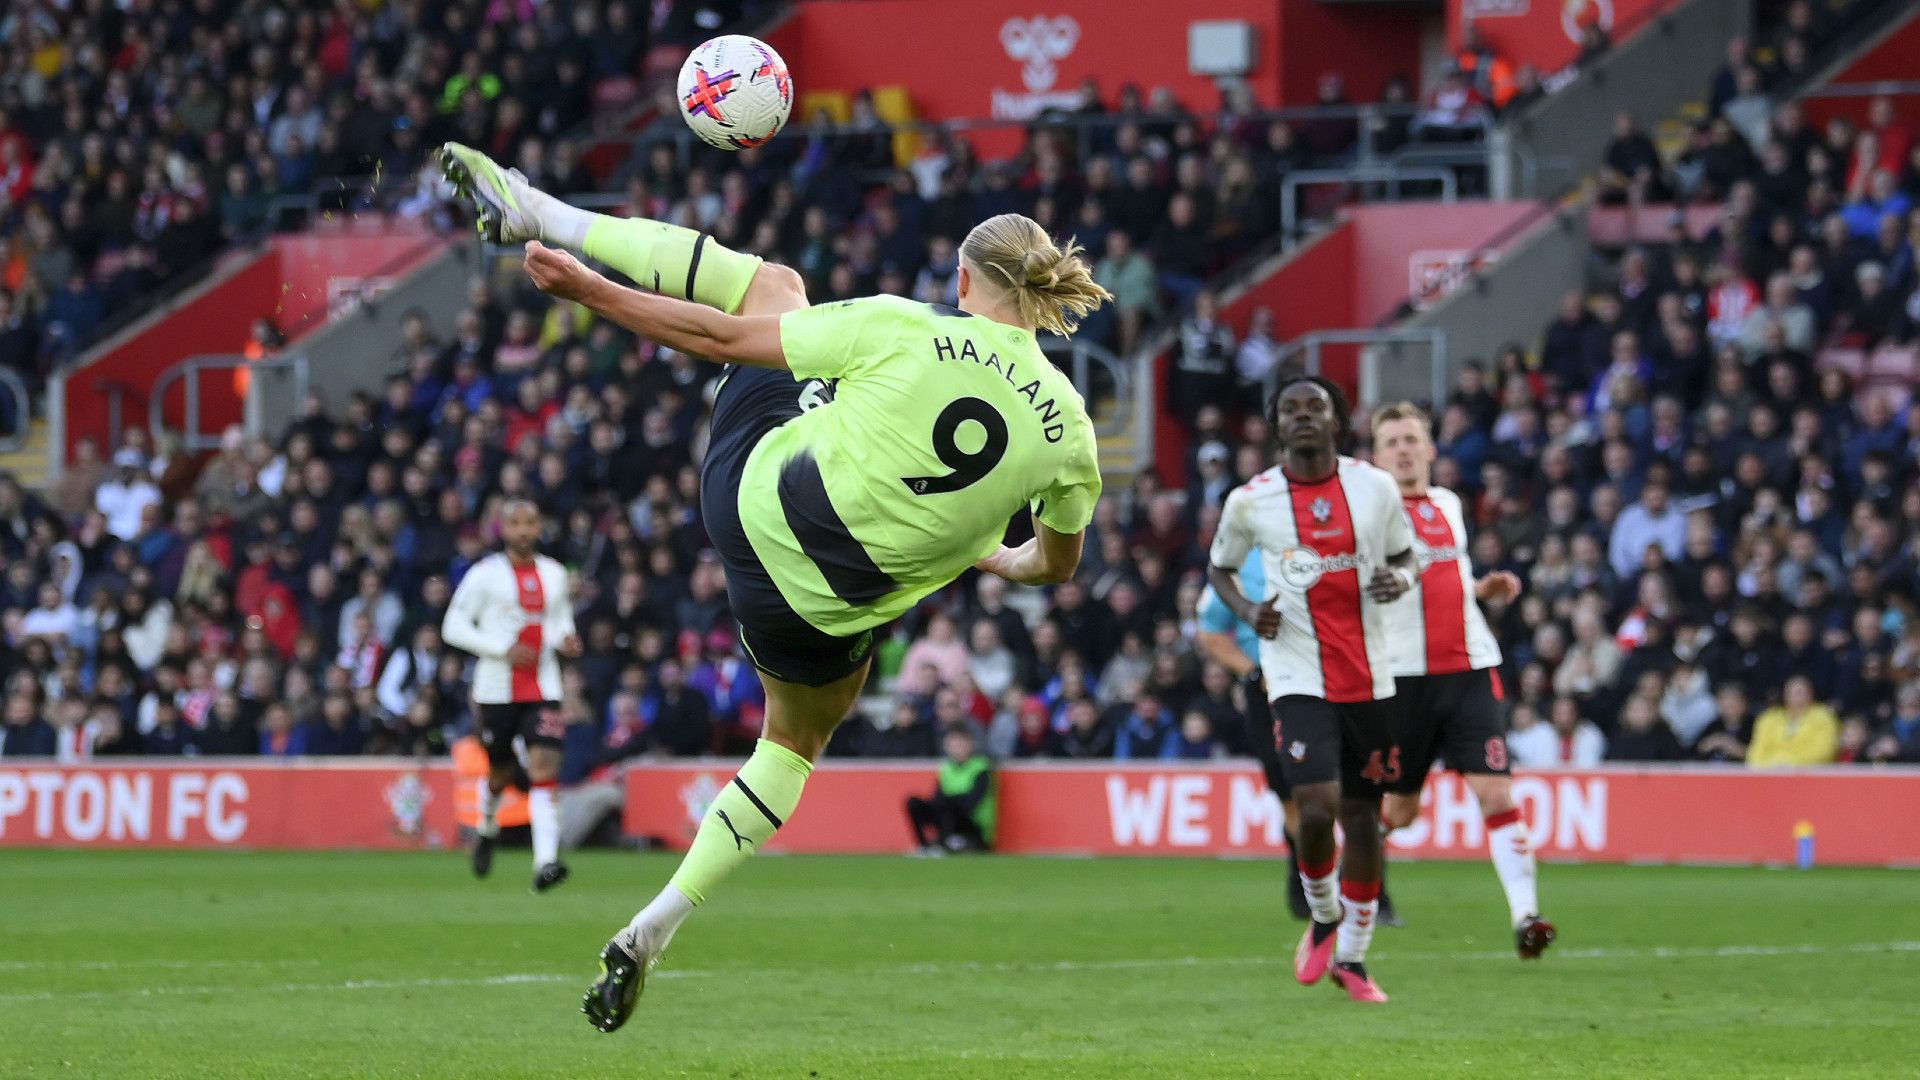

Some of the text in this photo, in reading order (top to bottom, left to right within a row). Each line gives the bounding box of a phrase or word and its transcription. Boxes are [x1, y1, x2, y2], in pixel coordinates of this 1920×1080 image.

[934, 336, 1064, 444] HAALAND
[901, 396, 1009, 495] 9
[0, 771, 249, 843] PTON FC
[1105, 775, 1608, 850] WE MCH ON
